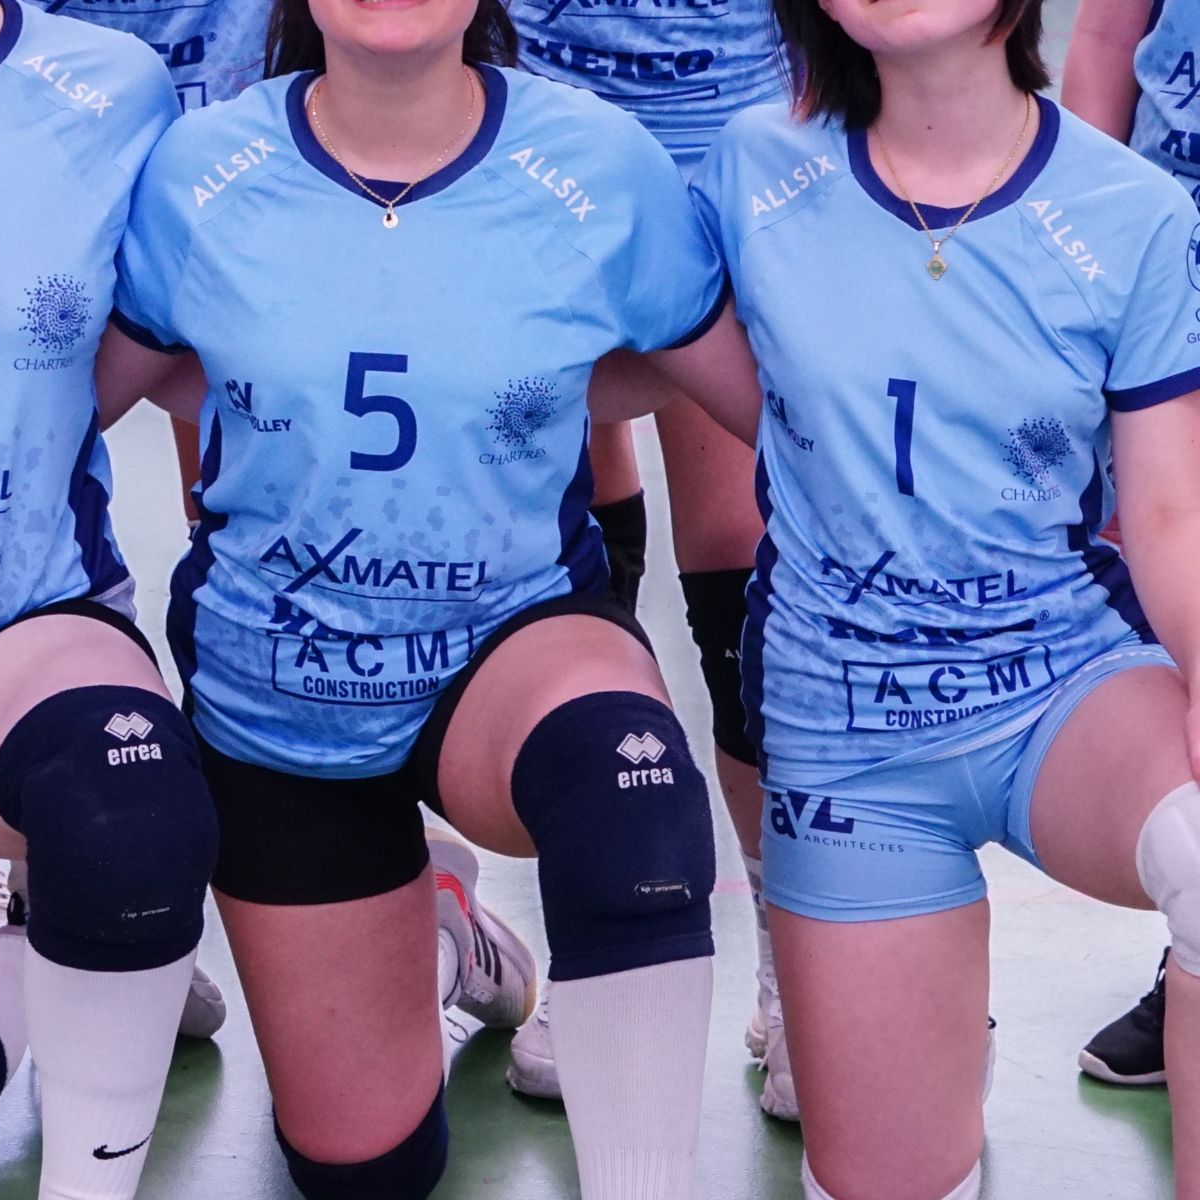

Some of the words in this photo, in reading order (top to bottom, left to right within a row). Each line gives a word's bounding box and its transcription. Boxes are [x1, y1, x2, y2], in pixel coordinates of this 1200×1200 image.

[22, 55, 114, 119] ALLSIX
[526, 39, 715, 81] HEICO
[193, 138, 276, 208] ALLSIX
[509, 147, 597, 223] ALLSIX
[751, 155, 837, 216] ALLSIX
[1027, 200, 1106, 282] ALLSIX
[342, 351, 418, 472] 5
[887, 377, 917, 498] 1
[259, 528, 492, 595] AXMATEL
[302, 675, 440, 700] CONSTRUCTION
[803, 834, 905, 853] ARCHITECTES
